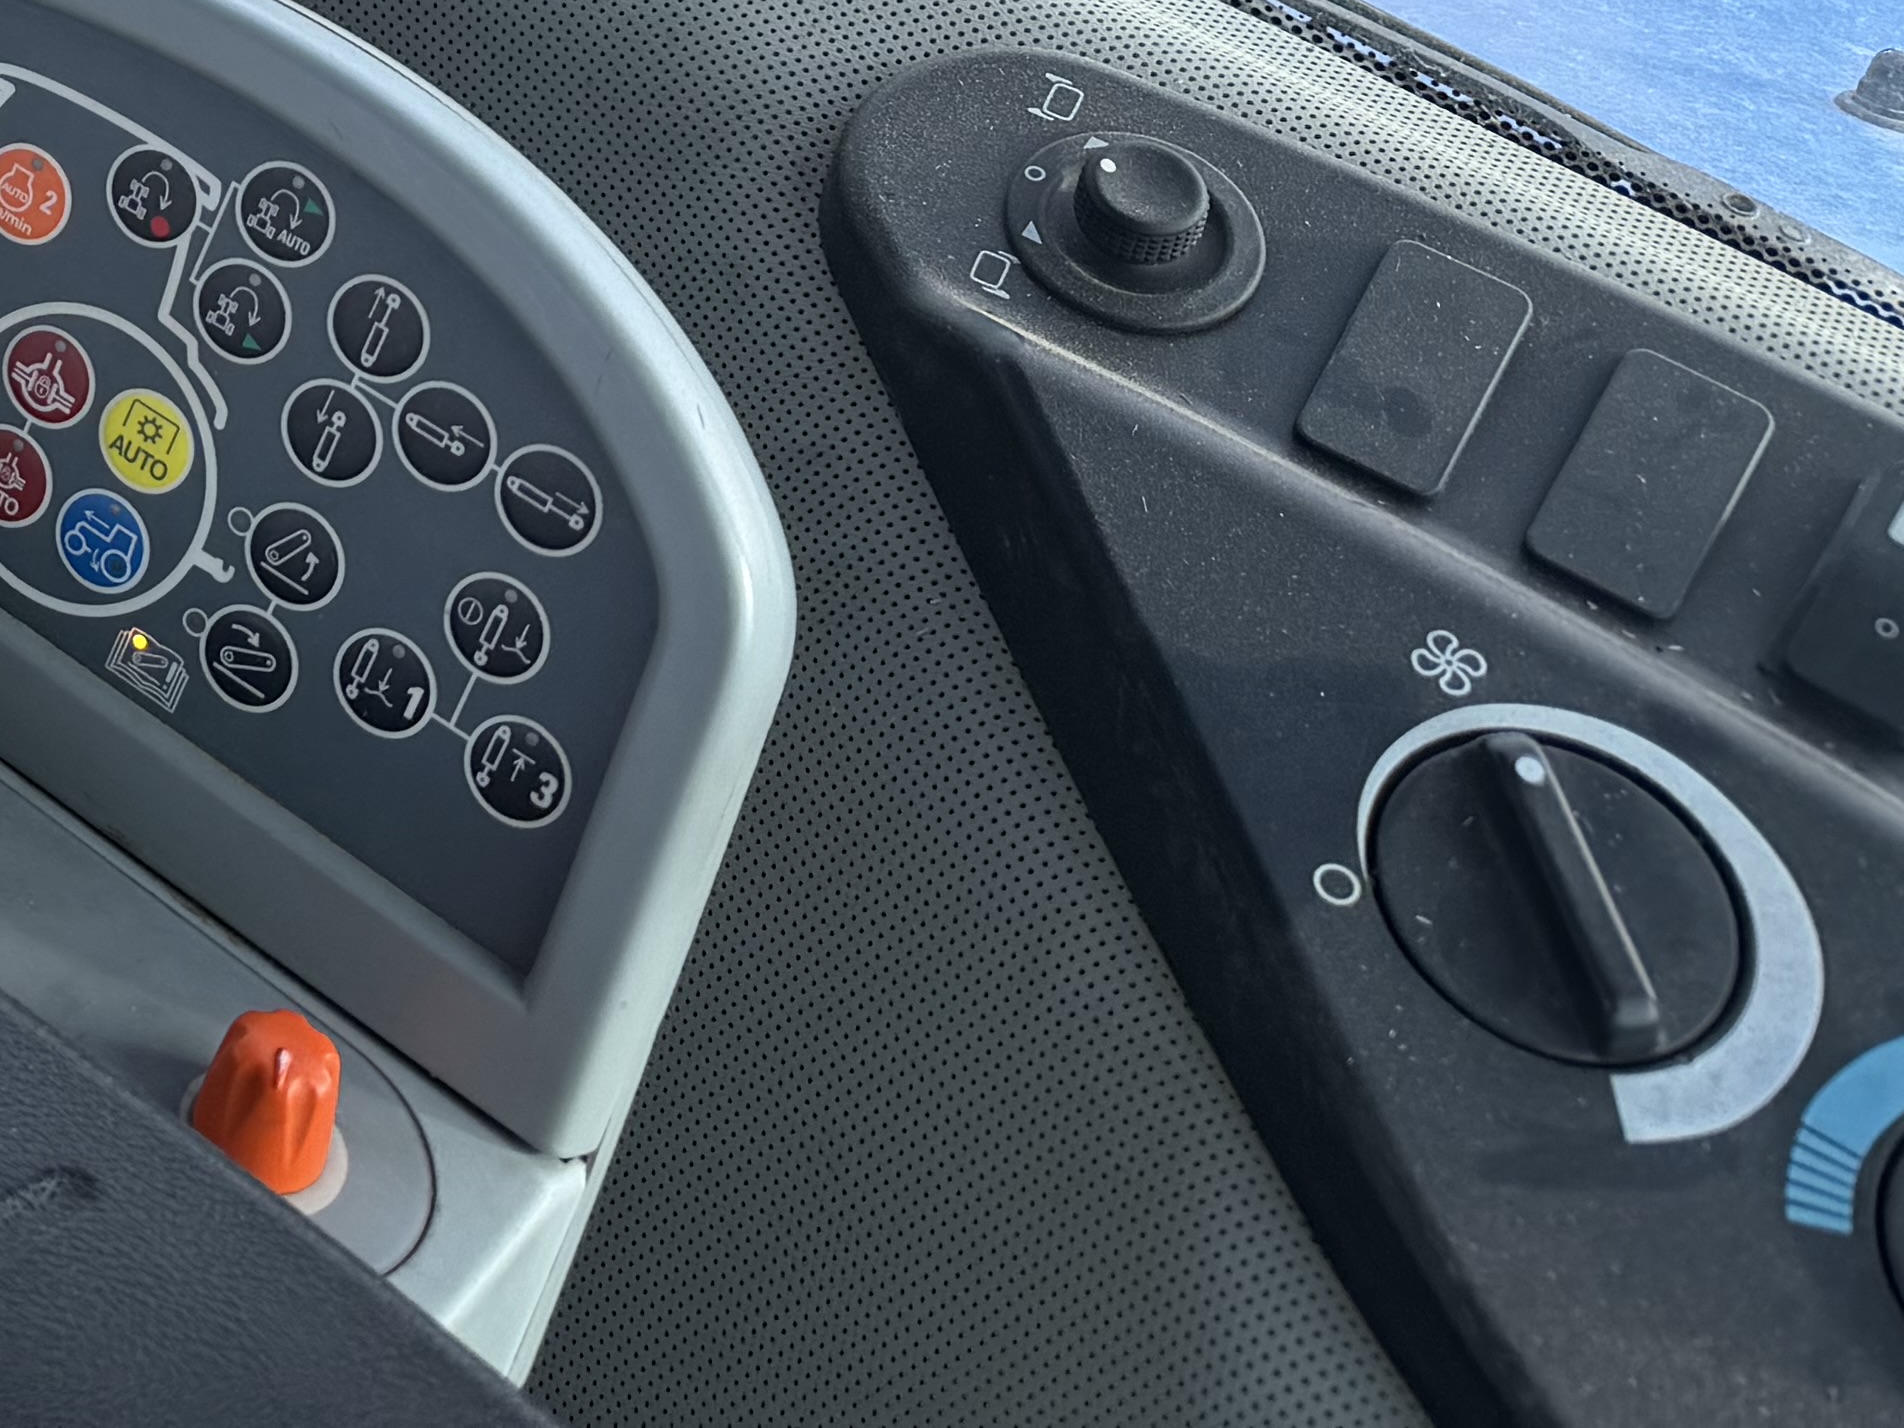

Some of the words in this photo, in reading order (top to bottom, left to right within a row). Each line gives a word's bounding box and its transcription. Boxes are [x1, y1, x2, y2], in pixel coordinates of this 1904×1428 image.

[2, 180, 29, 203] AUTO
[39, 190, 58, 216] 2
[276, 229, 311, 257] AUTO
[108, 433, 169, 482] AUTO
[403, 685, 425, 721] 1
[529, 771, 559, 809] 3
